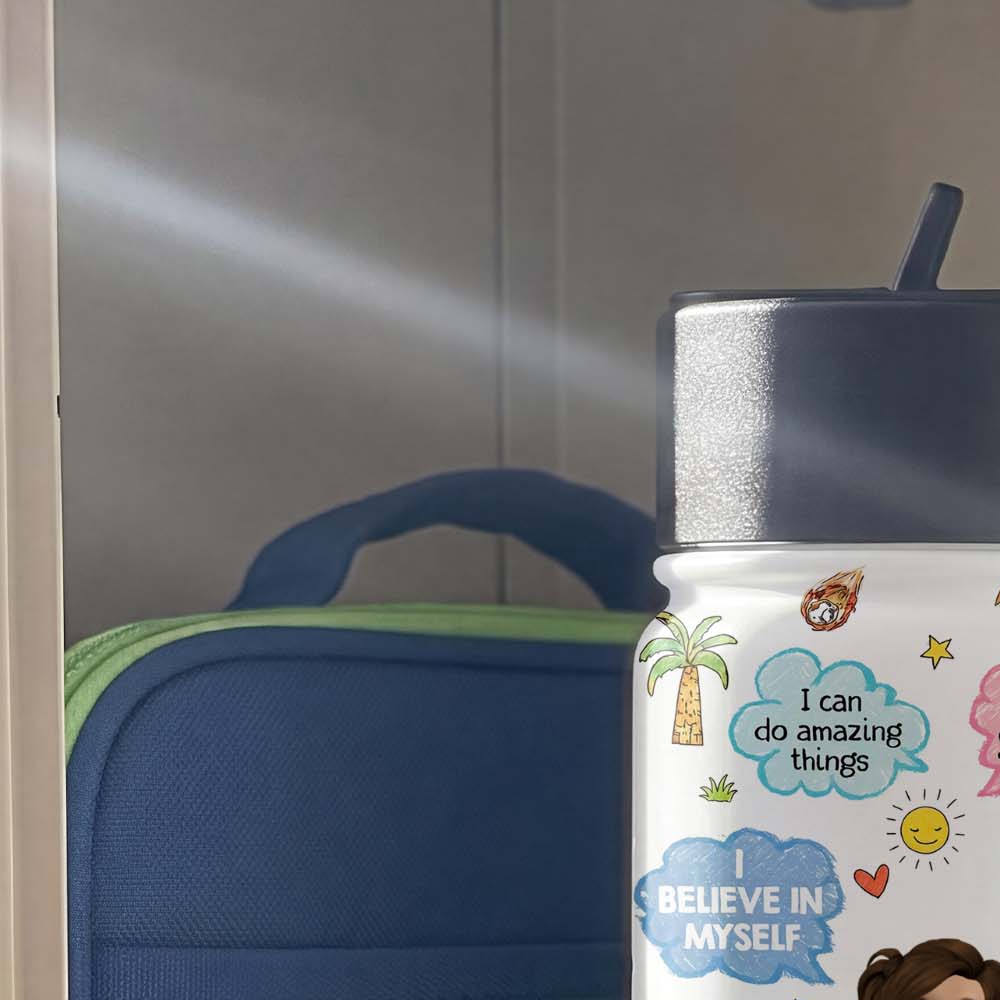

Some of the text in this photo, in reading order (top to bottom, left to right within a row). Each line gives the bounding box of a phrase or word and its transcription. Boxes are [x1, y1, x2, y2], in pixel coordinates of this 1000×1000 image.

[800, 687, 861, 713] I can
[755, 718, 901, 747] do amazing
[792, 748, 869, 776] things
[735, 848, 743, 879] I
[658, 885, 822, 914] BELIEVE IN
[684, 924, 801, 952] MYSELF
